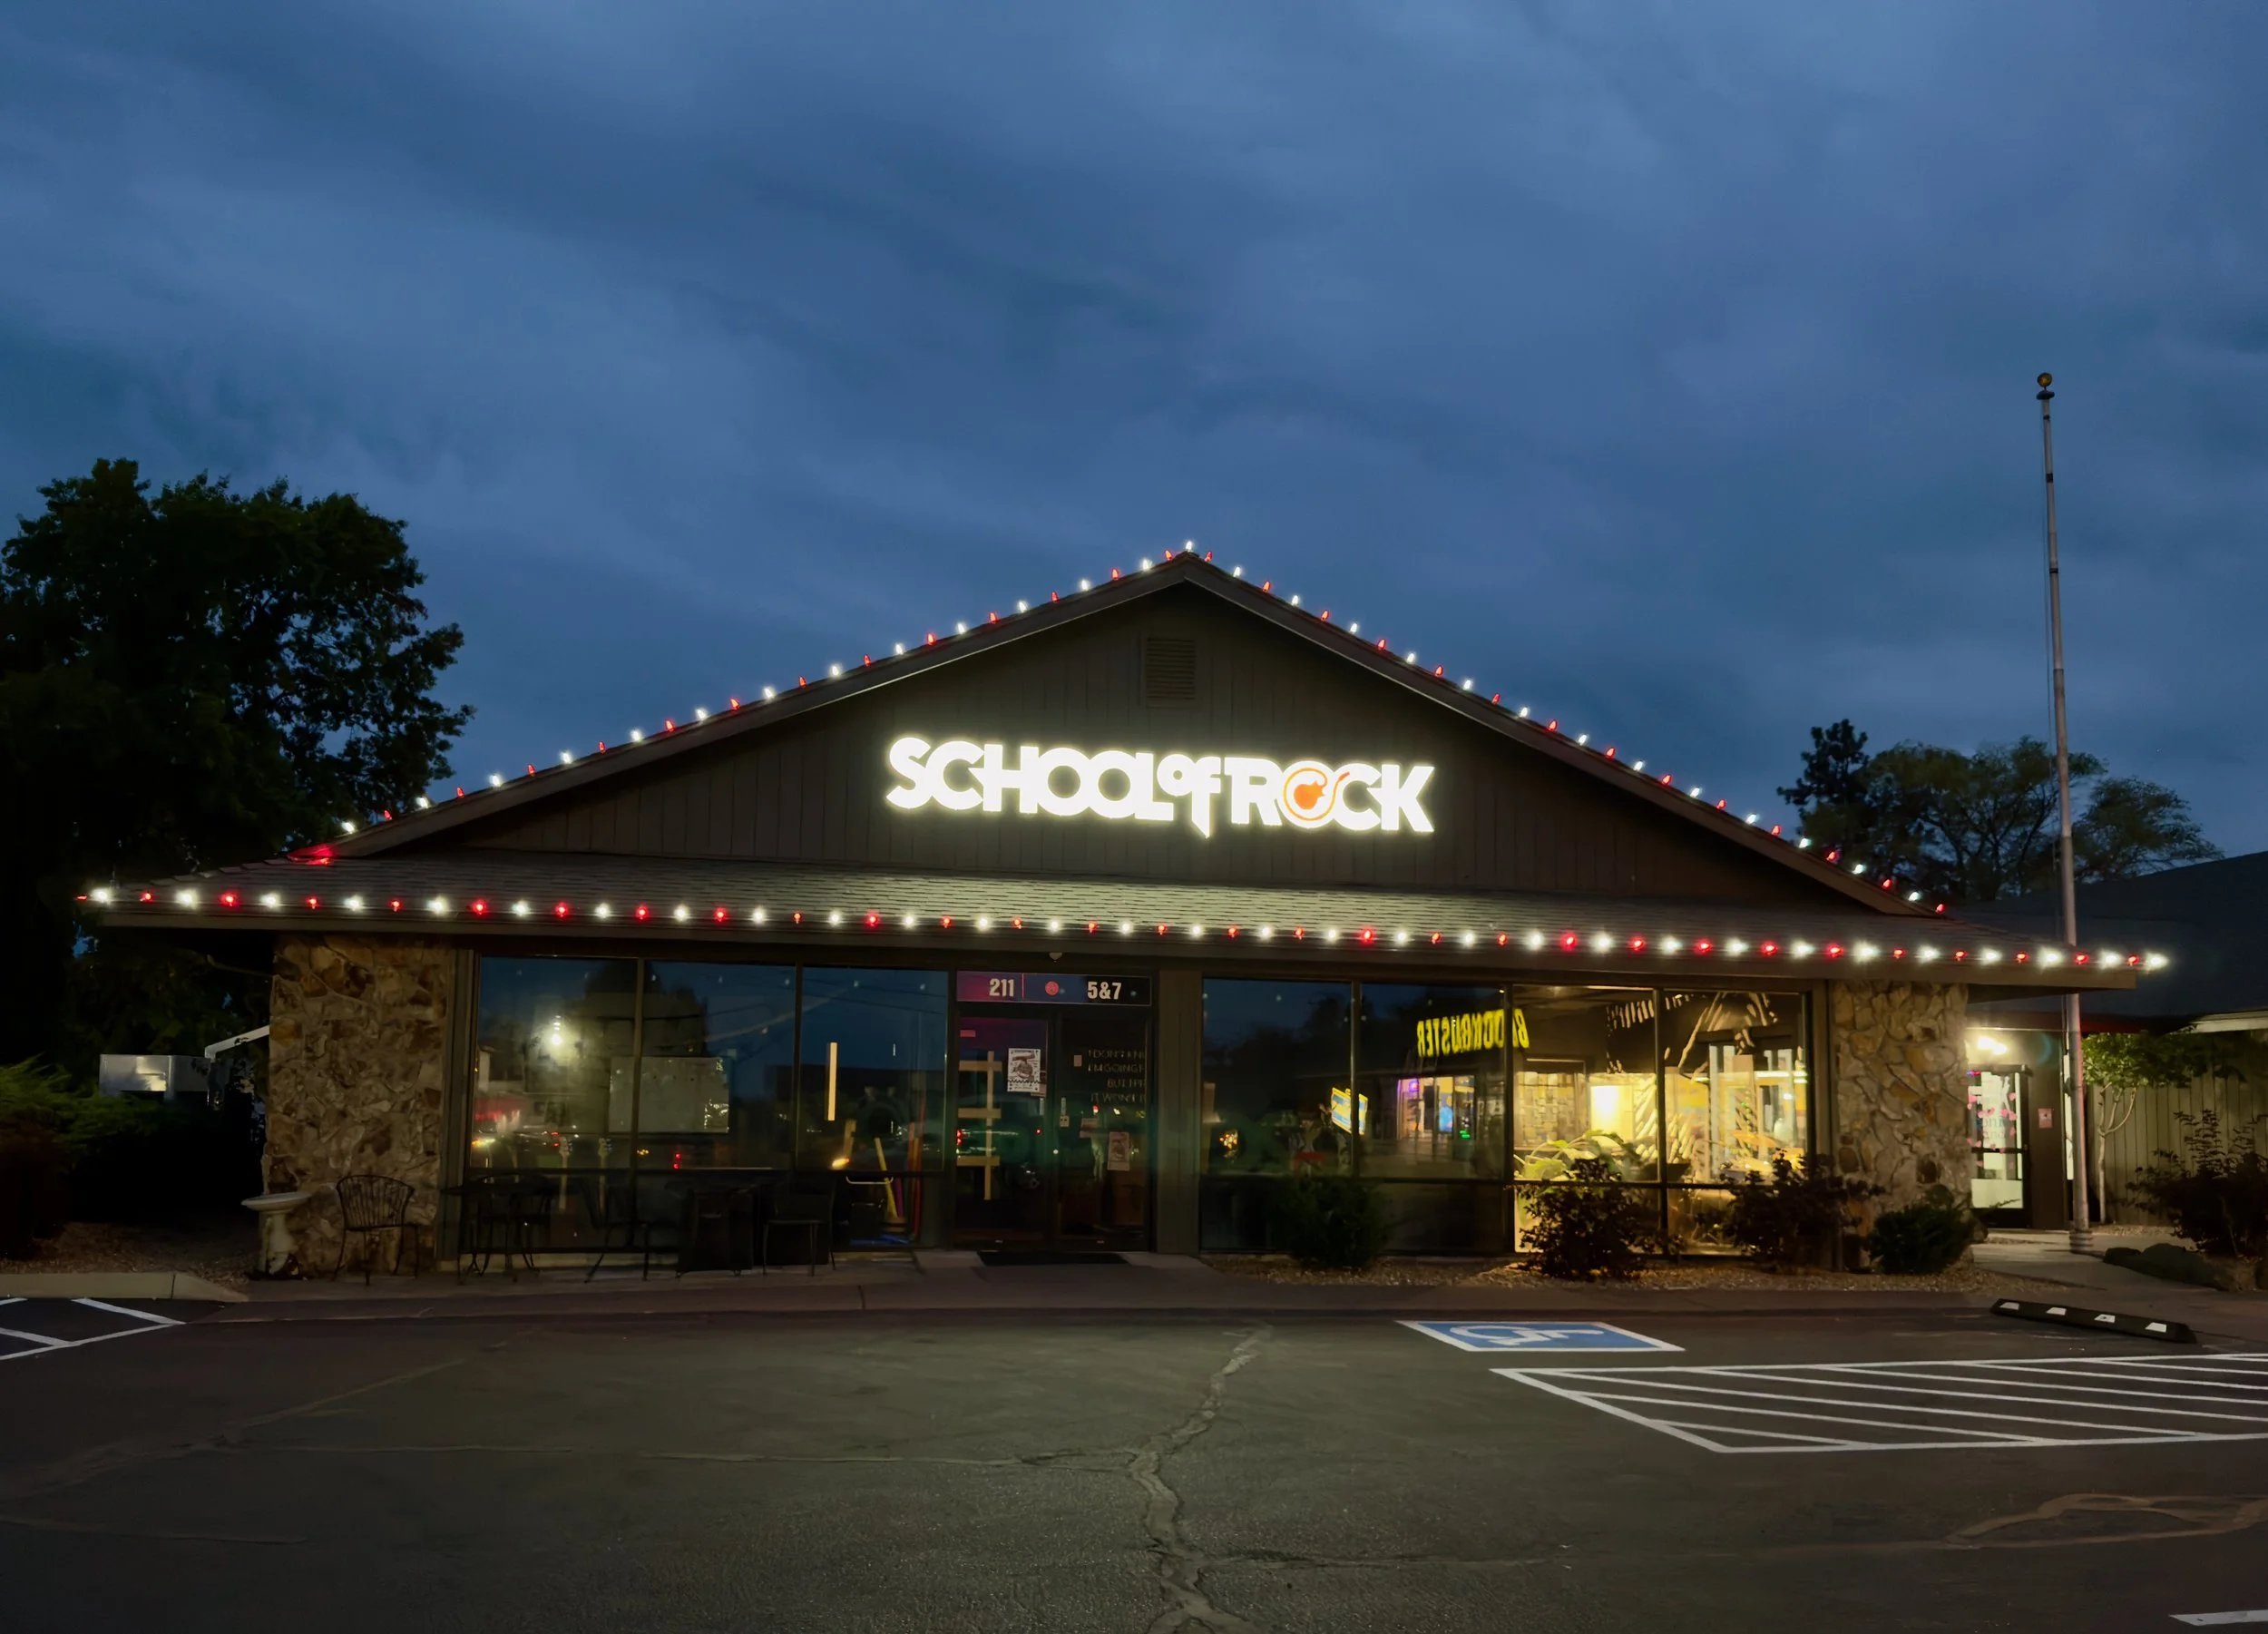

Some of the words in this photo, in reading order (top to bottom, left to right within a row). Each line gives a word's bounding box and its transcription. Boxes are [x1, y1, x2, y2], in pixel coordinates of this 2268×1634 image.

[886, 738, 1173, 821] SCHOOL
[1224, 758, 1434, 832] ROCK
[989, 978, 1014, 997] 211
[1087, 981, 1121, 1000] 5&7
